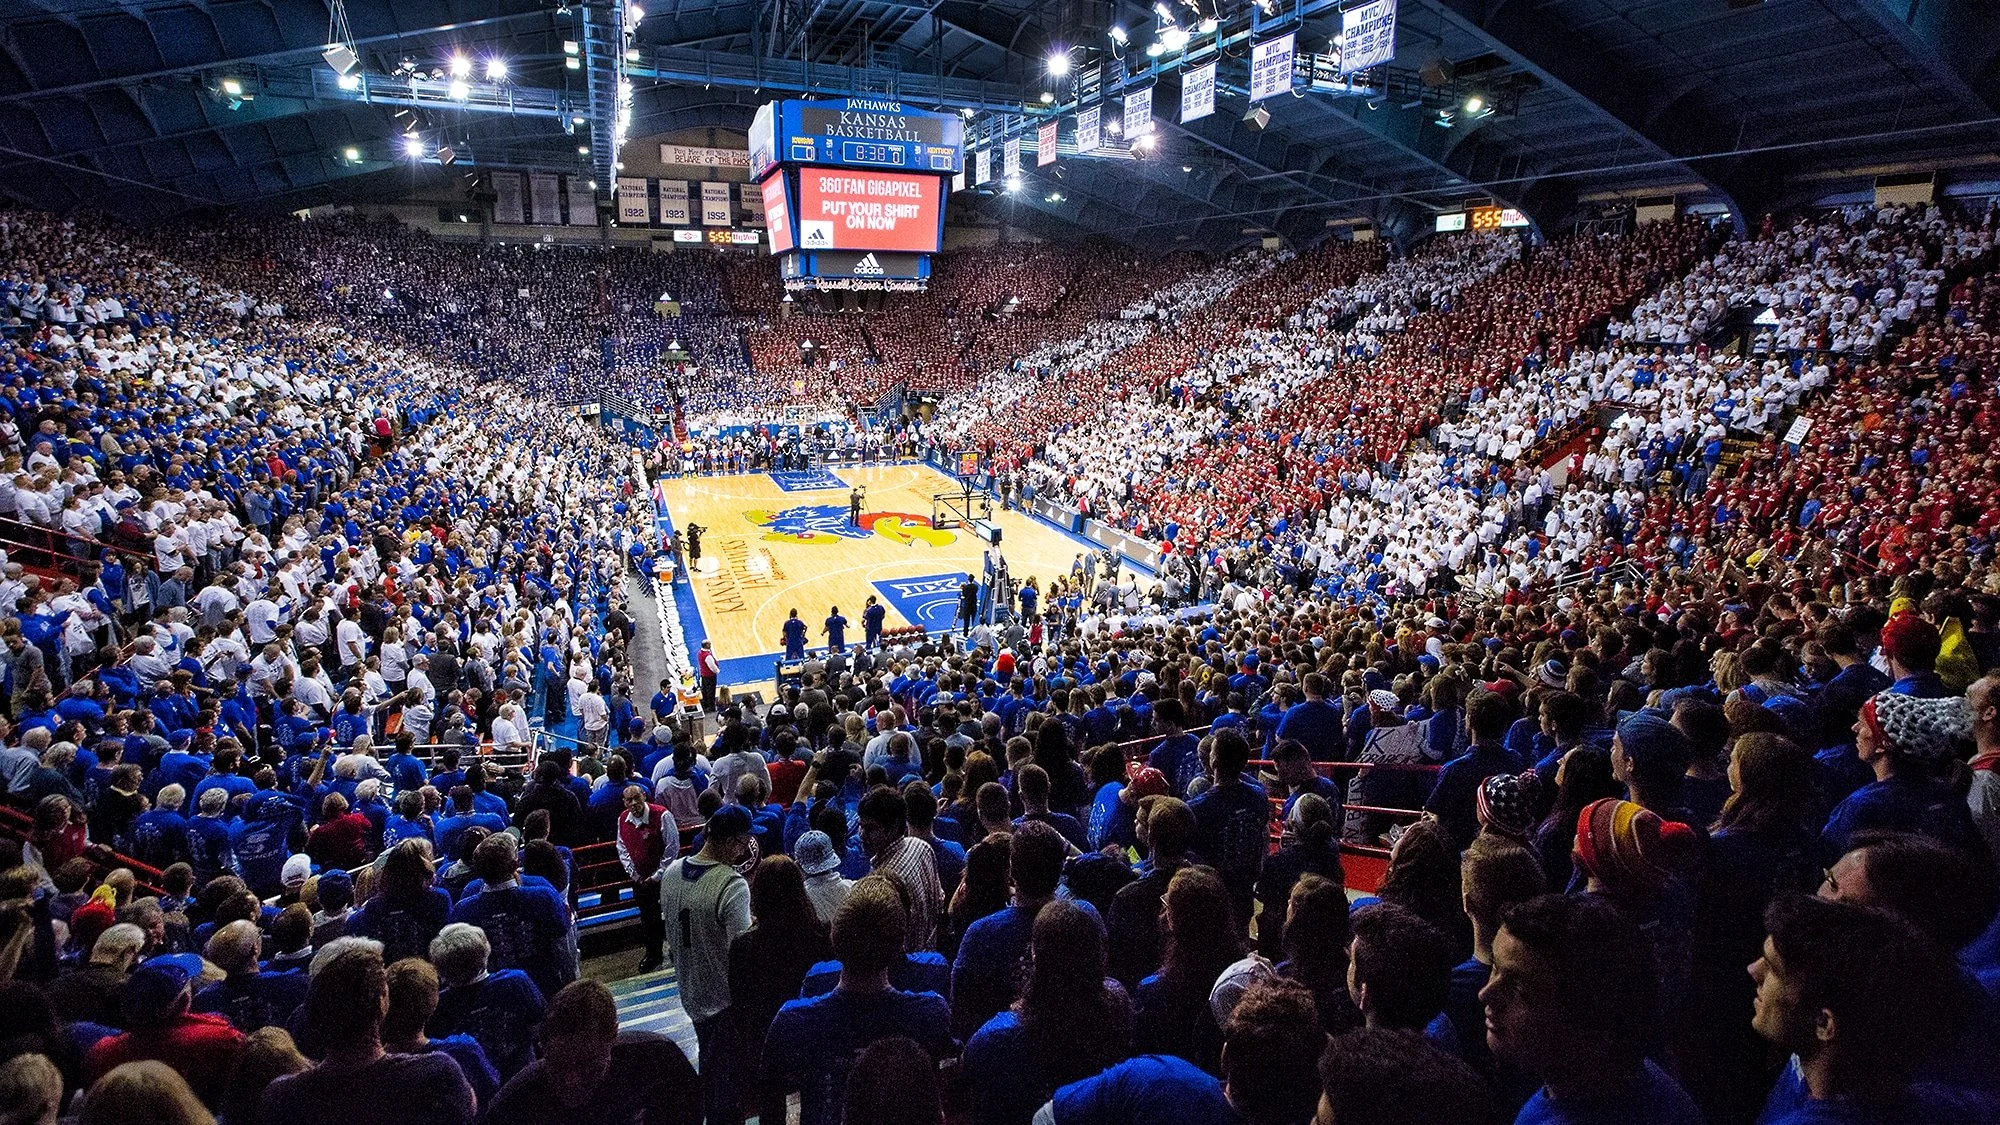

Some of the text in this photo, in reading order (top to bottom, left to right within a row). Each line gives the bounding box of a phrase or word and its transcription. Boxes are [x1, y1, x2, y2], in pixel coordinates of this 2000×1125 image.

[1360, 5, 1380, 22] MVC
[1346, 12, 1393, 40] CHAMPIONS
[1266, 42, 1280, 56] MVC
[1254, 50, 1291, 72] CHAMPIONS
[1184, 77, 1213, 96] CHAMPIONS
[847, 98, 901, 112] JAYHAWKS
[840, 112, 906, 128] KANSAS
[826, 124, 921, 142] BASKETBALL
[674, 154, 700, 164] BEWARE
[732, 158, 750, 166] PHO
[844, 179, 864, 194] FAN
[868, 180, 922, 198] GIGAPIXEL
[624, 208, 644, 217] 1922
[666, 210, 684, 218] 1923
[707, 212, 726, 220] 1952
[822, 201, 920, 218] PUT YOUR SHIRT
[846, 216, 896, 230] ON NOW
[1472, 210, 1502, 228] 5:55
[709, 231, 732, 242] 5:55
[816, 276, 850, 293] Russell
[851, 276, 883, 292] Stover
[884, 276, 919, 292] Candies
[720, 540, 776, 590] JAYHAWKS
[700, 568, 747, 614] KANSAS
[679, 907, 691, 948] 1
